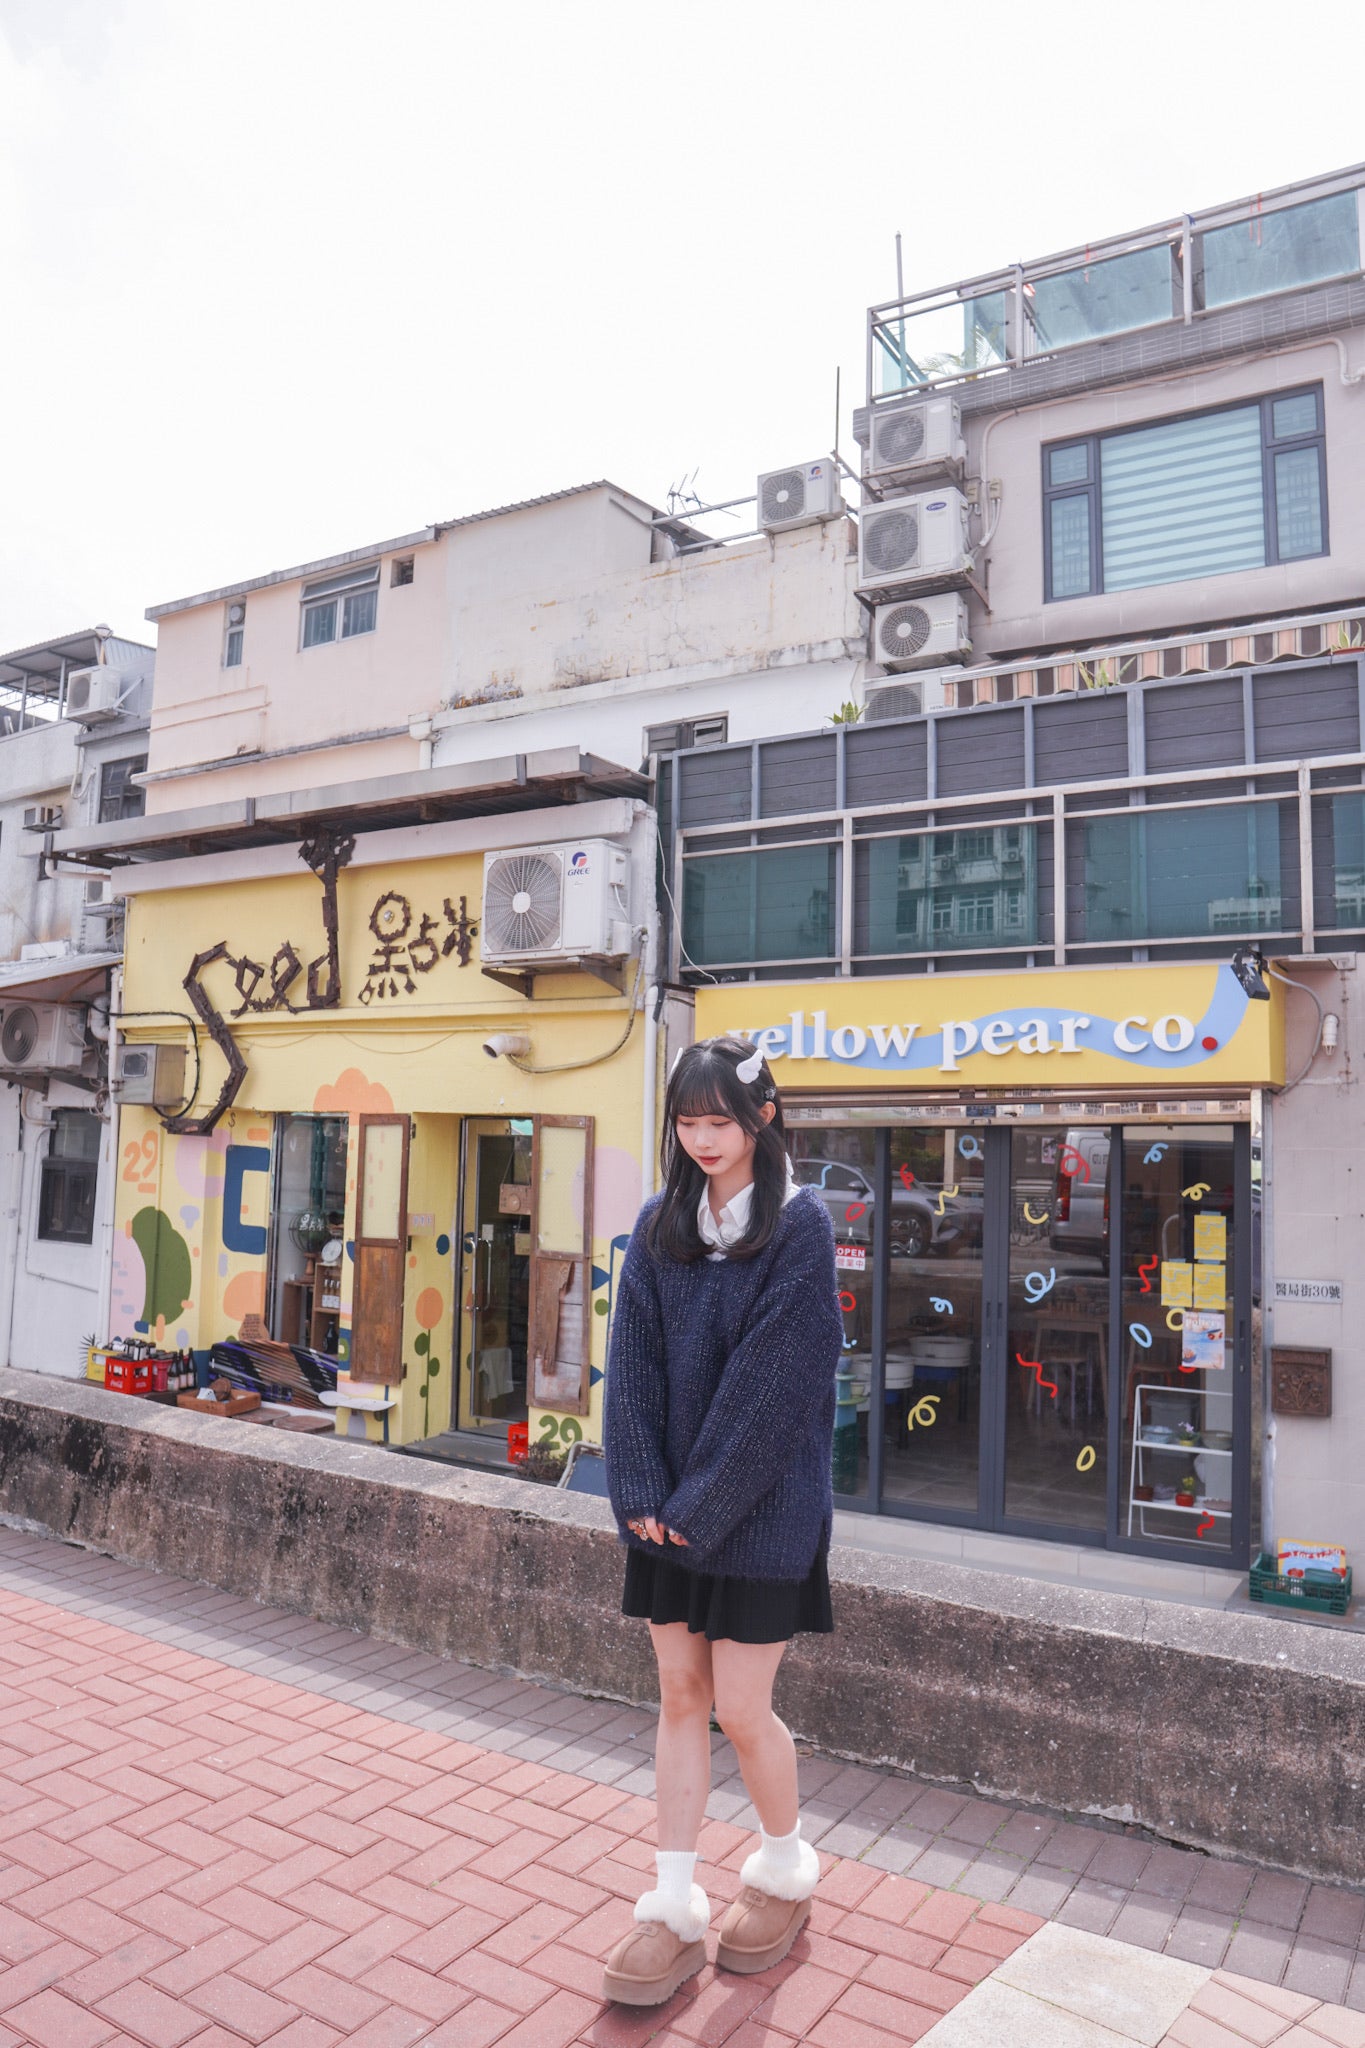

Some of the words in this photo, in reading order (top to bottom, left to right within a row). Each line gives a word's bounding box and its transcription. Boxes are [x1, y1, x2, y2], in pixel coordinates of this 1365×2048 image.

[567, 867, 591, 877] GREE
[938, 1016, 1091, 1072] pear
[122, 1129, 158, 1182] 29
[836, 1247, 865, 1258] OPEN
[539, 1414, 582, 1459] 29
